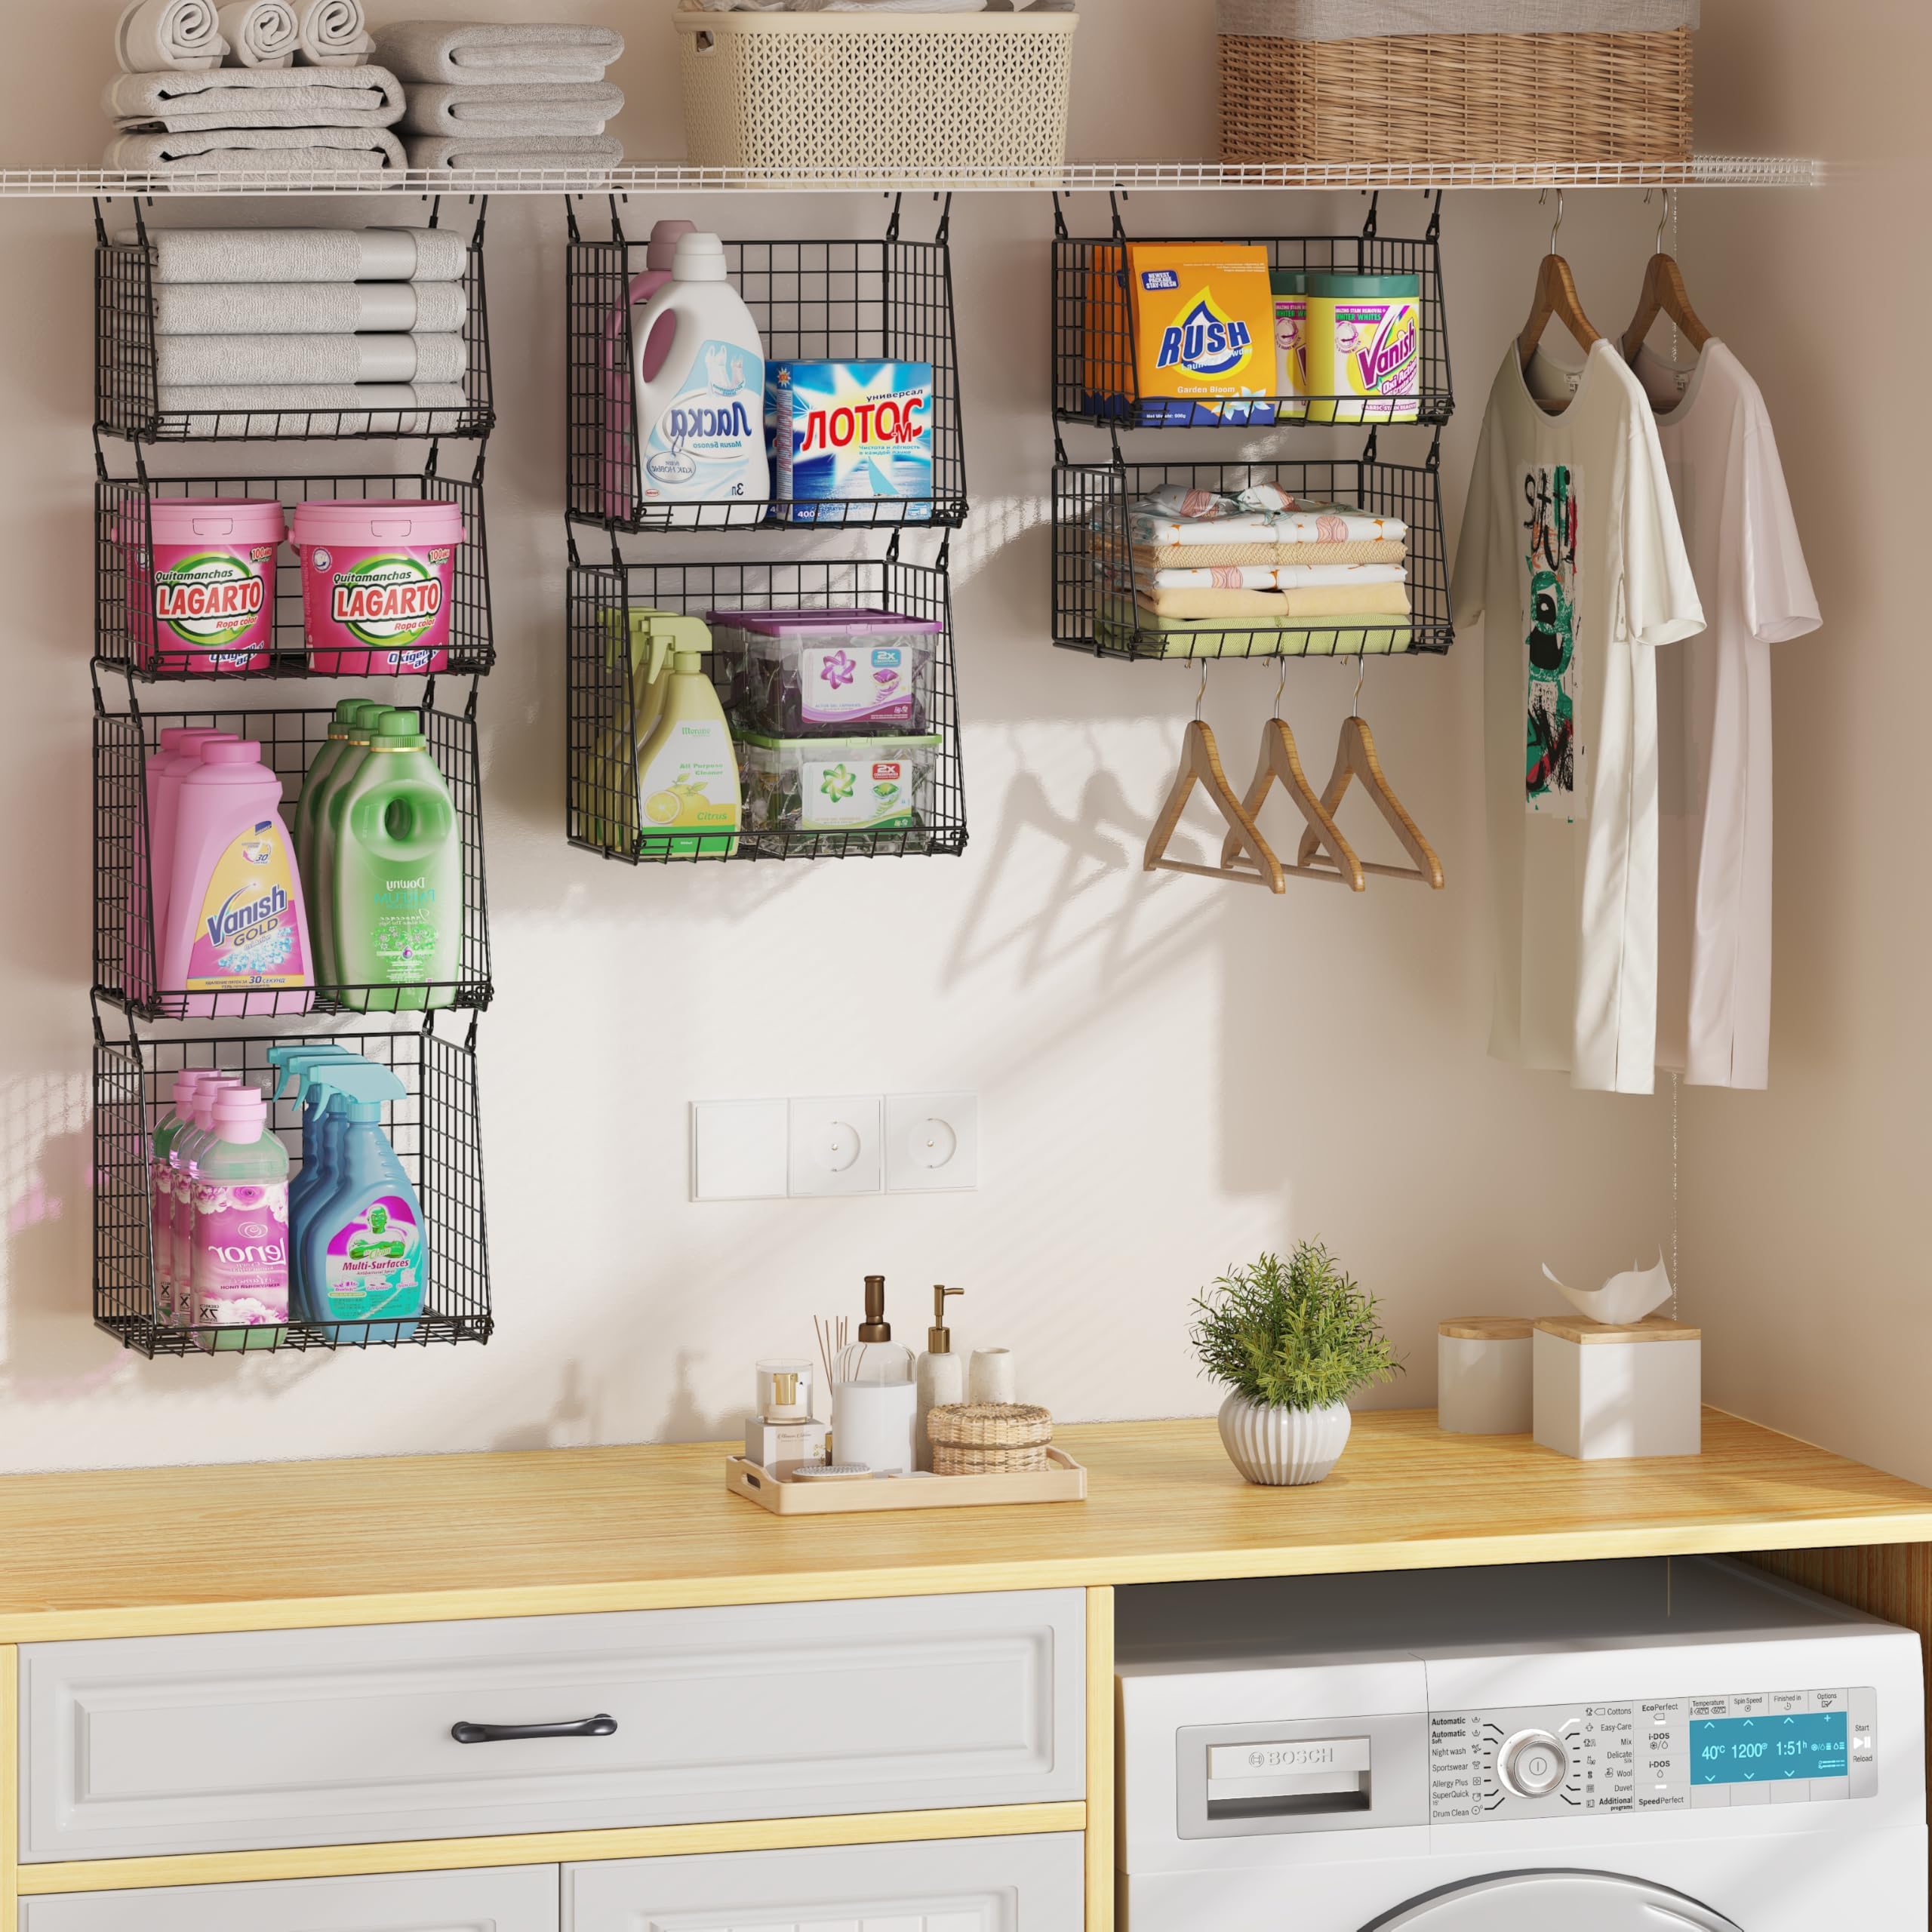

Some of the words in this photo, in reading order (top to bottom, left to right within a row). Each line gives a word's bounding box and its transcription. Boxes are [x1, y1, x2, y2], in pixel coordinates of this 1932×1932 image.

[1157, 321, 1251, 368] RUSH
[1358, 315, 1416, 389] Vanish
[866, 389, 923, 402] универсал
[801, 398, 922, 451] ЛОТОС
[155, 569, 233, 582] Quitamanchas
[334, 571, 411, 583] Quitamanchas
[158, 580, 261, 616] LAGARTO
[337, 583, 438, 617] LAGARTO
[216, 620, 238, 629] Ropa
[240, 617, 257, 625] color
[394, 621, 417, 631] Ropa
[418, 618, 435, 627] color
[697, 811, 728, 821] Citrus
[255, 854, 269, 862] 30
[207, 884, 287, 946] Vanish
[234, 918, 278, 946] GOLD
[249, 976, 262, 984] 30
[342, 1260, 409, 1271] Multi-Surfaces
[1692, 1700, 1724, 1709] Temperature
[1746, 1697, 1762, 1706] Speed
[1642, 1703, 1678, 1712] EcoPerfect
[1432, 1717, 1466, 1725] Automatic
[1601, 1723, 1632, 1732] Easy-Care
[1432, 1730, 1466, 1738] Automatic
[1432, 1749, 1449, 1757] Night
[1607, 1751, 1632, 1759] Delicate
[1731, 1743, 1763, 1759] 1200
[1267, 1748, 1334, 1766] BOSCH
[1432, 1764, 1469, 1773] Sportswear
[1649, 1760, 1670, 1768] i-DOS
[1432, 1780, 1453, 1788] Allergy
[1432, 1790, 1469, 1800] SuperQuick
[1599, 1796, 1633, 1806] Additional
[1638, 1796, 1684, 1807] SpeedPerfect
